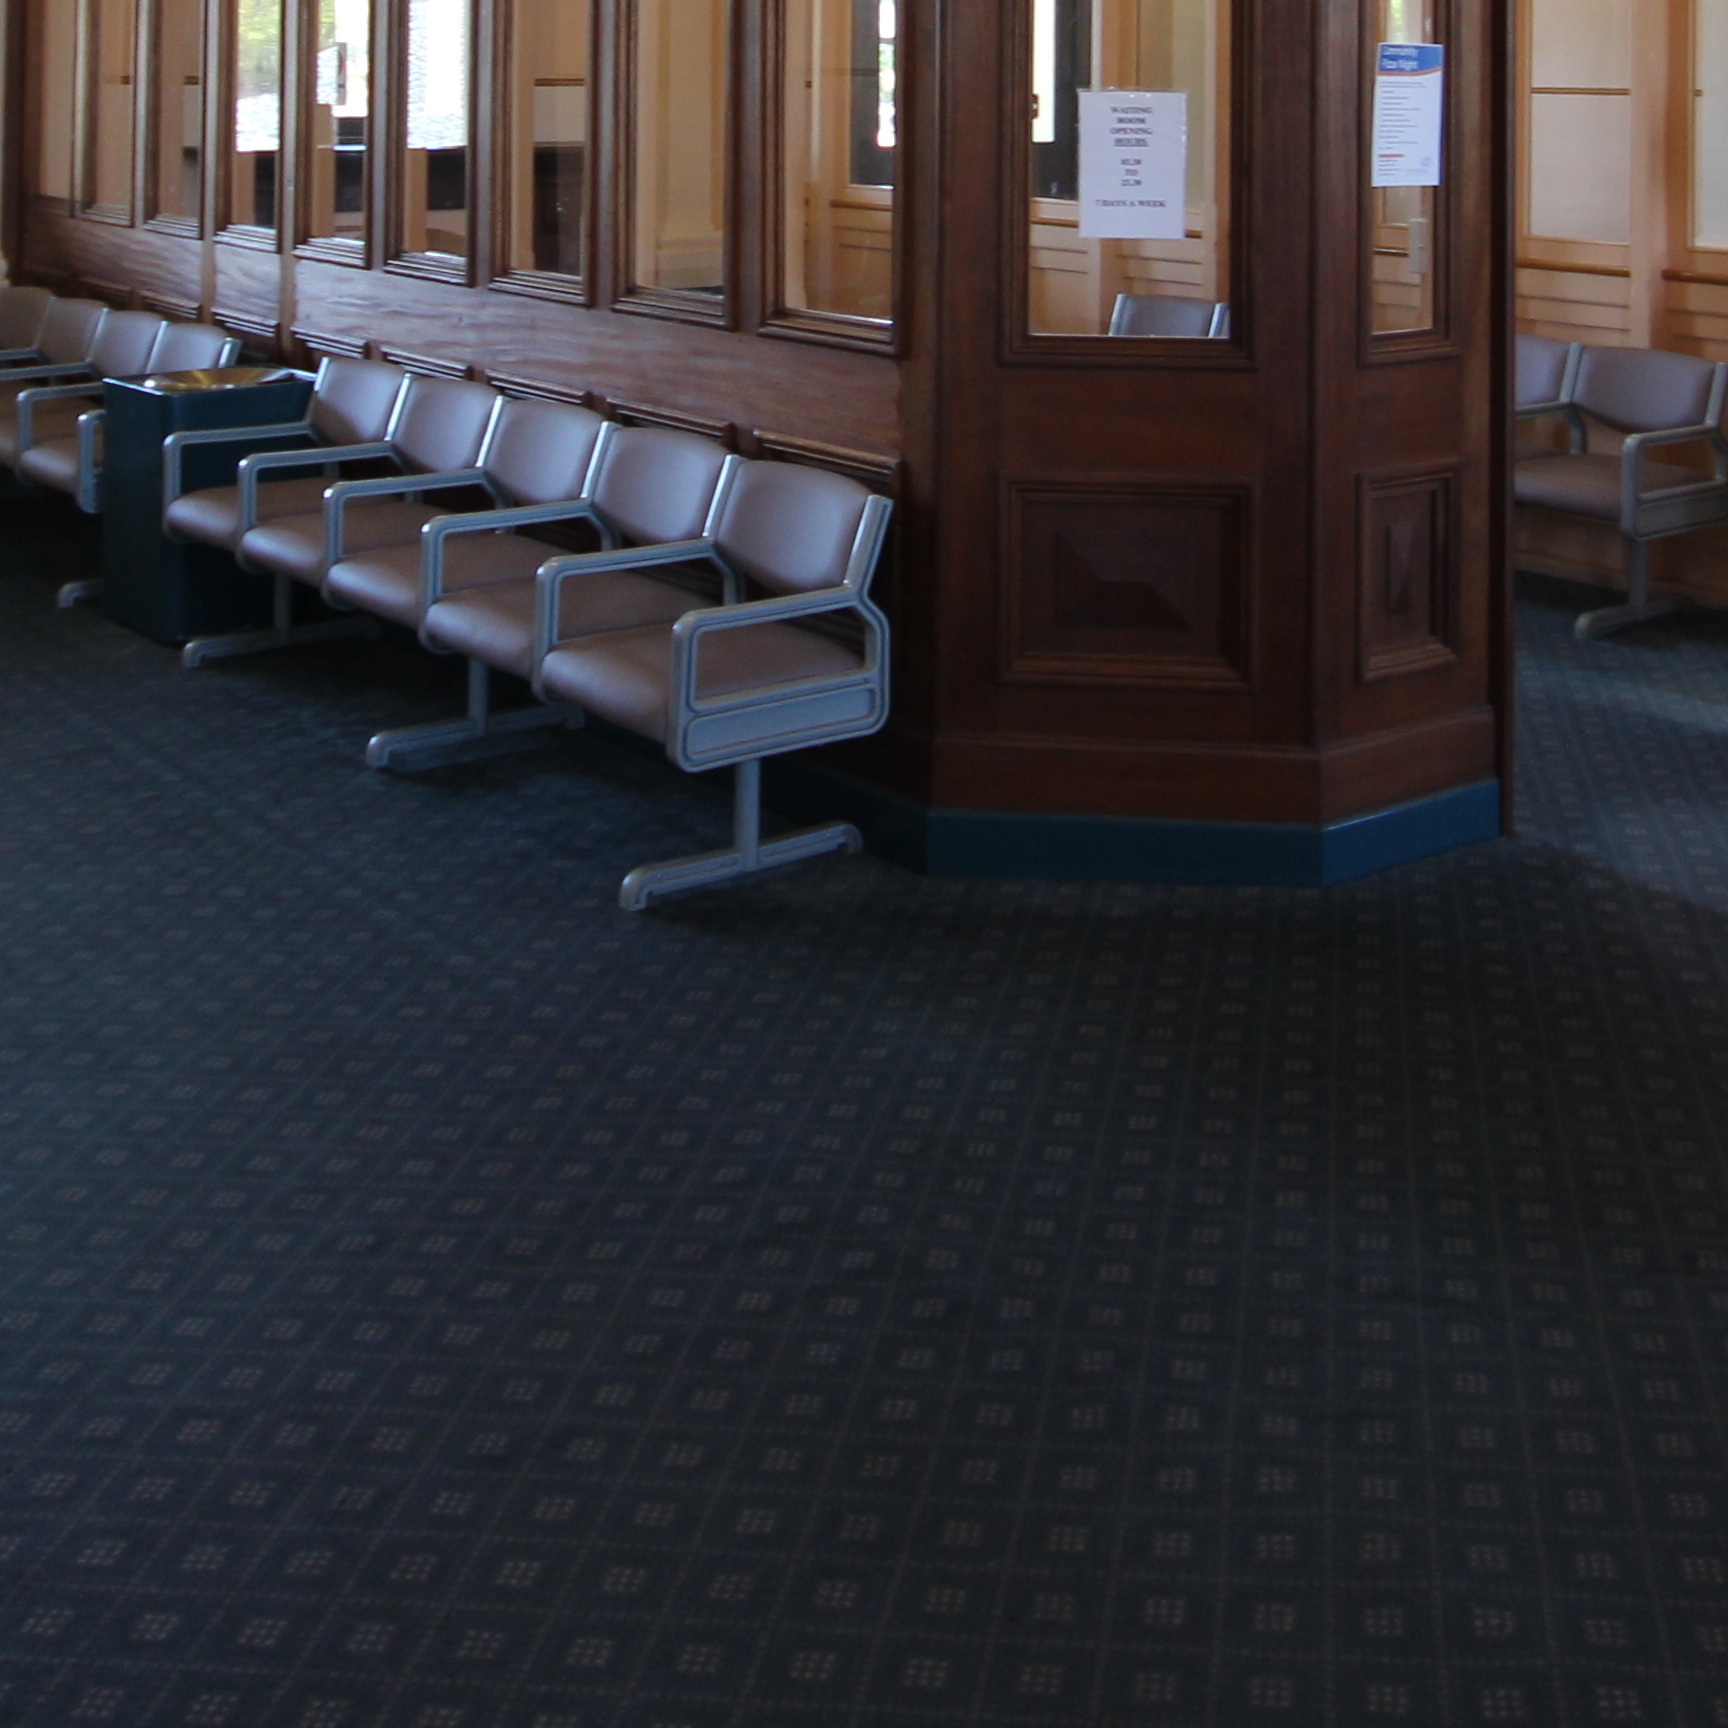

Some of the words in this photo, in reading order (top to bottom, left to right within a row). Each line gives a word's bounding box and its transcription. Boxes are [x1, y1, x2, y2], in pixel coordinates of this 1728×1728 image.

[1109, 106, 1154, 114] WAITING
[1109, 127, 1154, 135] OPENING
[1102, 199, 1127, 207] DAYS
[1138, 199, 1167, 208] WEEK
